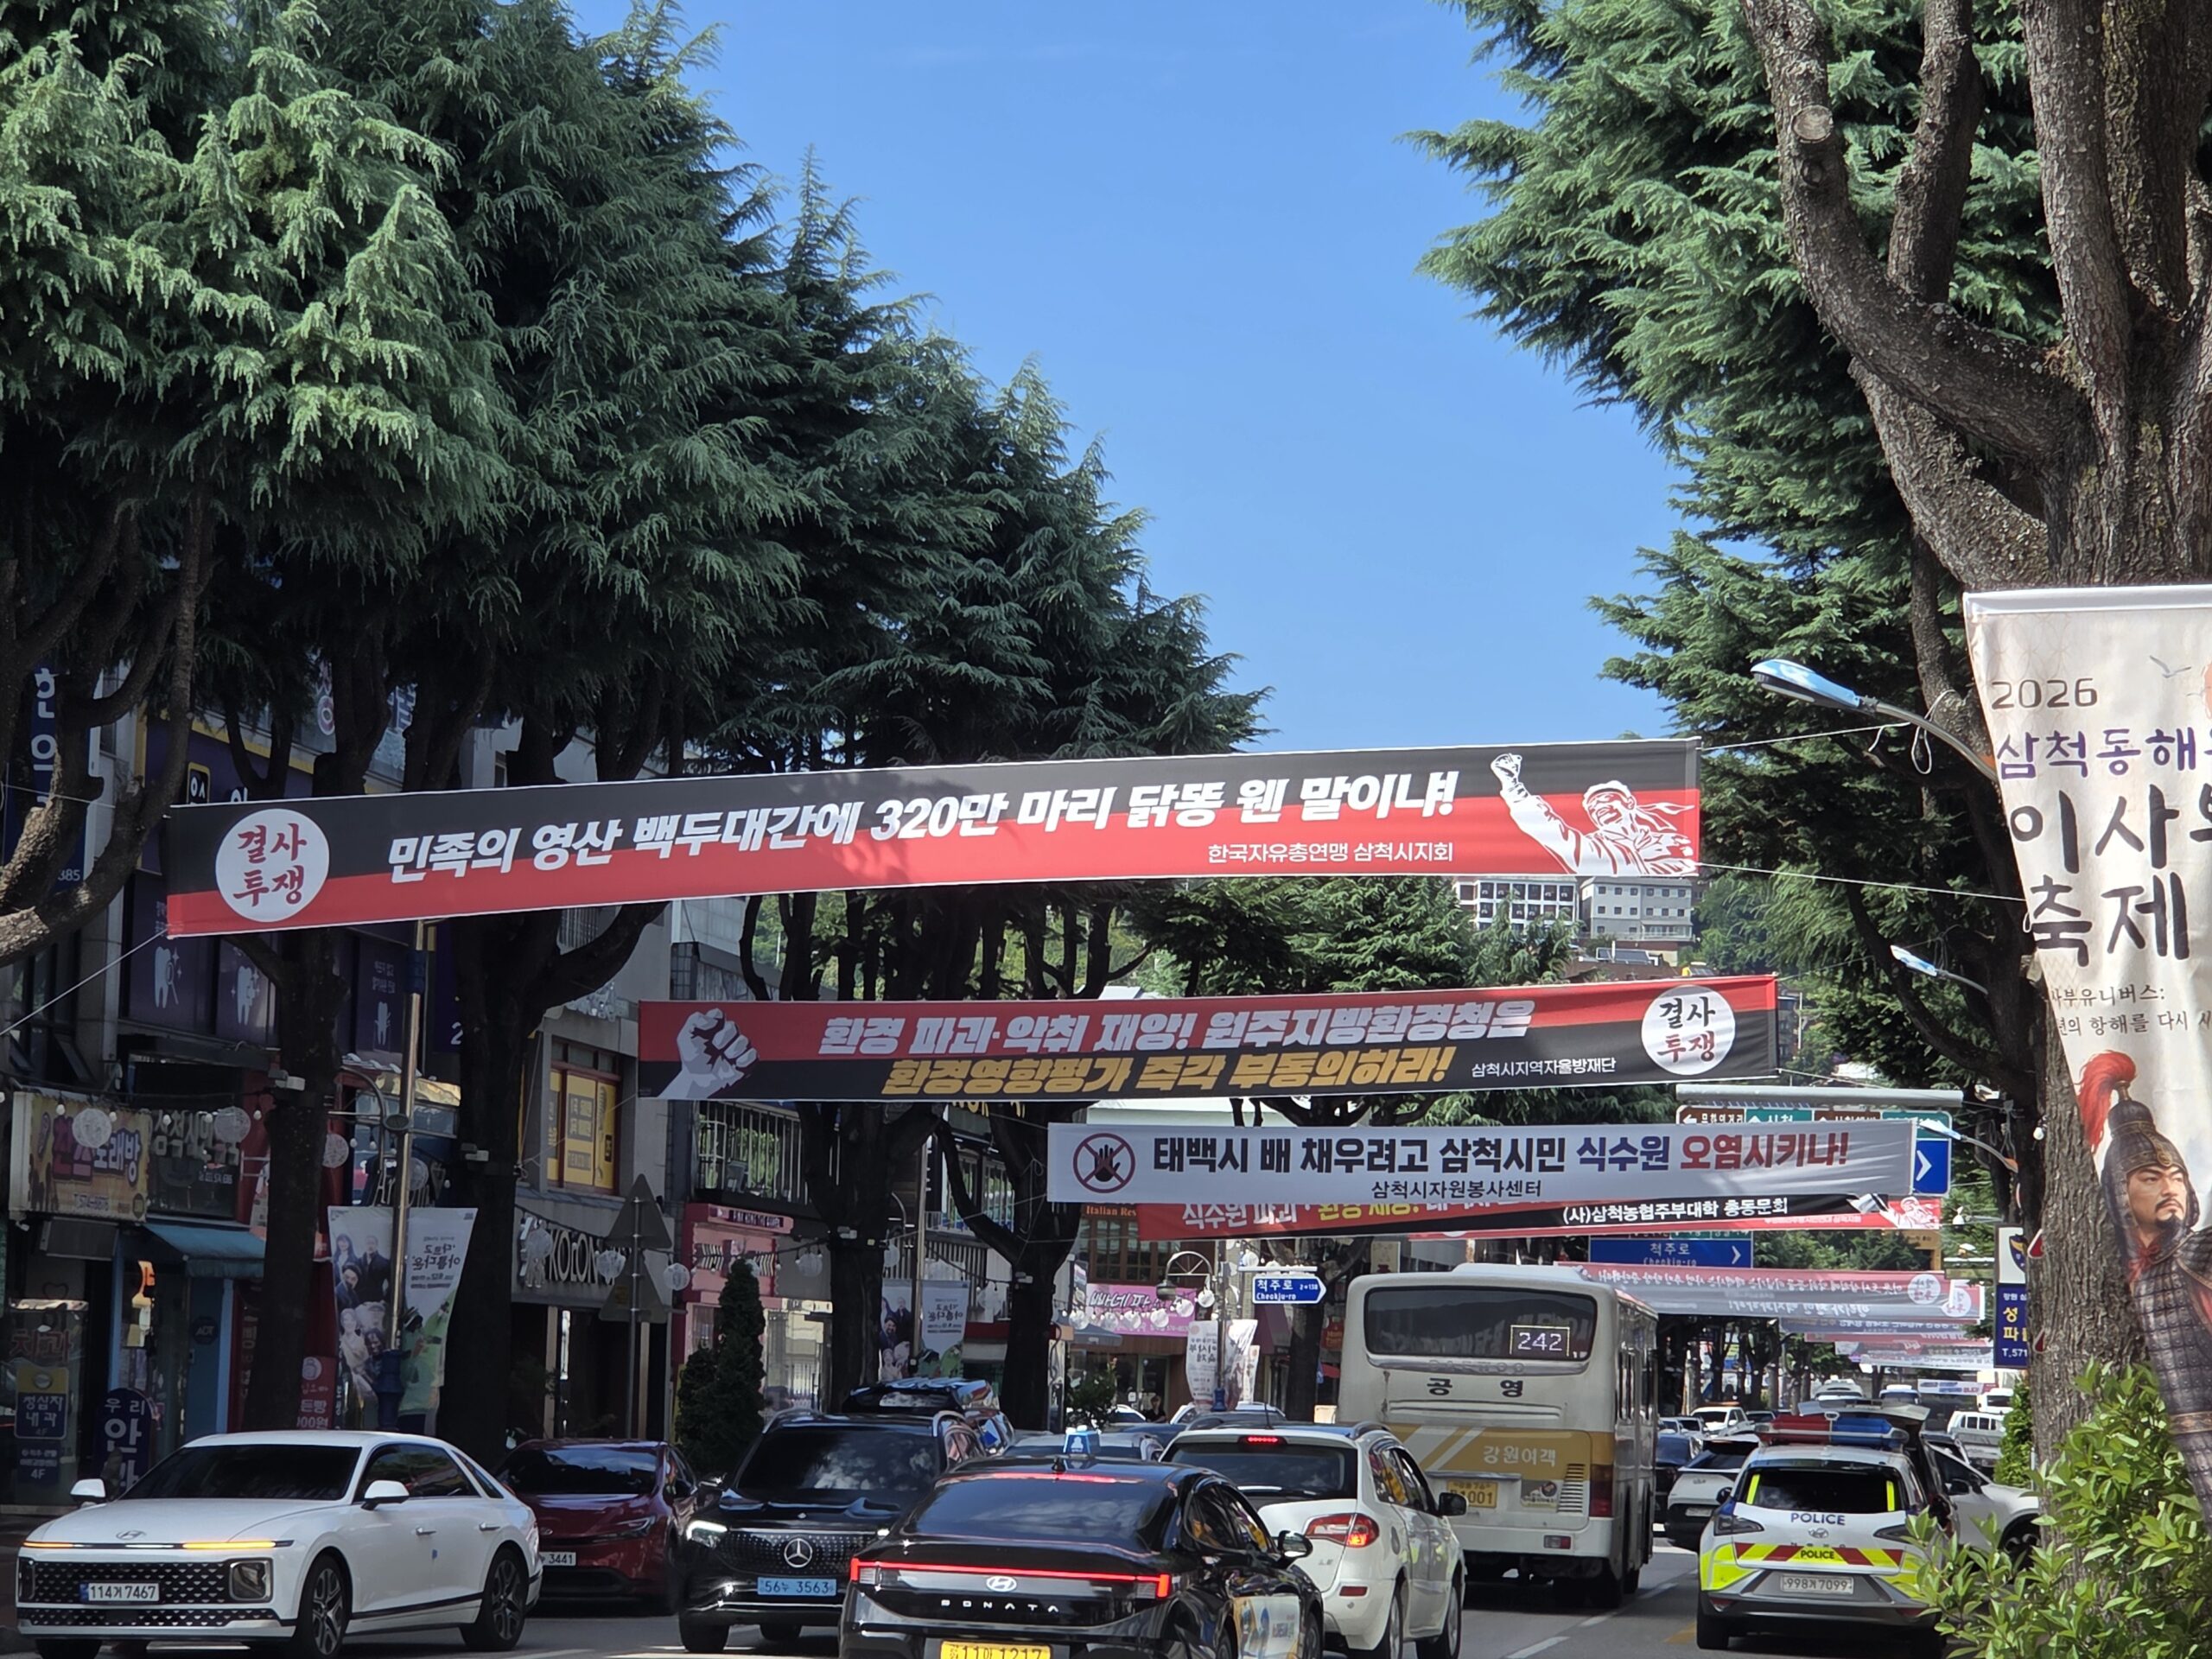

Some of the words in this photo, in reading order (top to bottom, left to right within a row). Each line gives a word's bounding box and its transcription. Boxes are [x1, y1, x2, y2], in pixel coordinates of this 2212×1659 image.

[1991, 677, 2098, 710] 2026
[1996, 727, 2212, 780] 삼척동해
[388, 828, 521, 883] 민족의
[532, 819, 623, 871] 영산
[632, 802, 864, 859] 백두대간에
[871, 792, 1008, 842] 320만
[1016, 787, 1118, 832] 마리
[1127, 781, 1228, 829] 닭똥
[1236, 778, 1290, 823] 웬
[1300, 771, 1459, 820] 말이냐!
[237, 823, 308, 861] 결사
[1208, 843, 1349, 864] 한국자유총연맹
[1353, 841, 1453, 862] 삼척시지회
[233, 867, 305, 906] 투쟁
[2031, 872, 2190, 968] 축제
[1659, 996, 1716, 1029] 결사
[2088, 1014, 2149, 1036] 항해를
[2158, 1011, 2188, 1031] 다시
[818, 1017, 906, 1055] 환경
[1093, 1013, 1198, 1052] 재앙!
[1200, 1000, 1535, 1049] 원주지방환경청은
[1657, 1033, 1716, 1063] 투쟁
[881, 1056, 1134, 1095] 환경영향평가
[1136, 1054, 1227, 1091] 즉각
[1227, 1047, 1456, 1088] 부동의하라!
[1471, 1058, 1617, 1079] 삼척시지역자율방재단
[1154, 1137, 1249, 1173] 태백시
[1261, 1138, 1291, 1173] 배
[1301, 1138, 1428, 1173] 채우려고
[1440, 1137, 1566, 1173] 삼척시민
[1576, 1135, 1670, 1173] 식수원
[1681, 1132, 1849, 1171] 오염시키나!
[1371, 1179, 1541, 1199] 삼척시자원봉사센터
[1086, 1205, 1118, 1216] Italian
[1563, 1202, 1719, 1225] (사)삼척농협주부대학
[1724, 1198, 1789, 1217] 총동문회
[1650, 1243, 1691, 1256] 척주로
[1257, 1280, 1293, 1292] 척주로
[1517, 1332, 1563, 1351] 242
[1483, 1445, 1556, 1466] 강원여객
[1790, 1513, 1846, 1526] POLICE
[549, 1554, 573, 1564] 3441
[1801, 1550, 1834, 1559] POLICE
[796, 1581, 829, 1593] 3563
[941, 1599, 1058, 1613] SONATA
